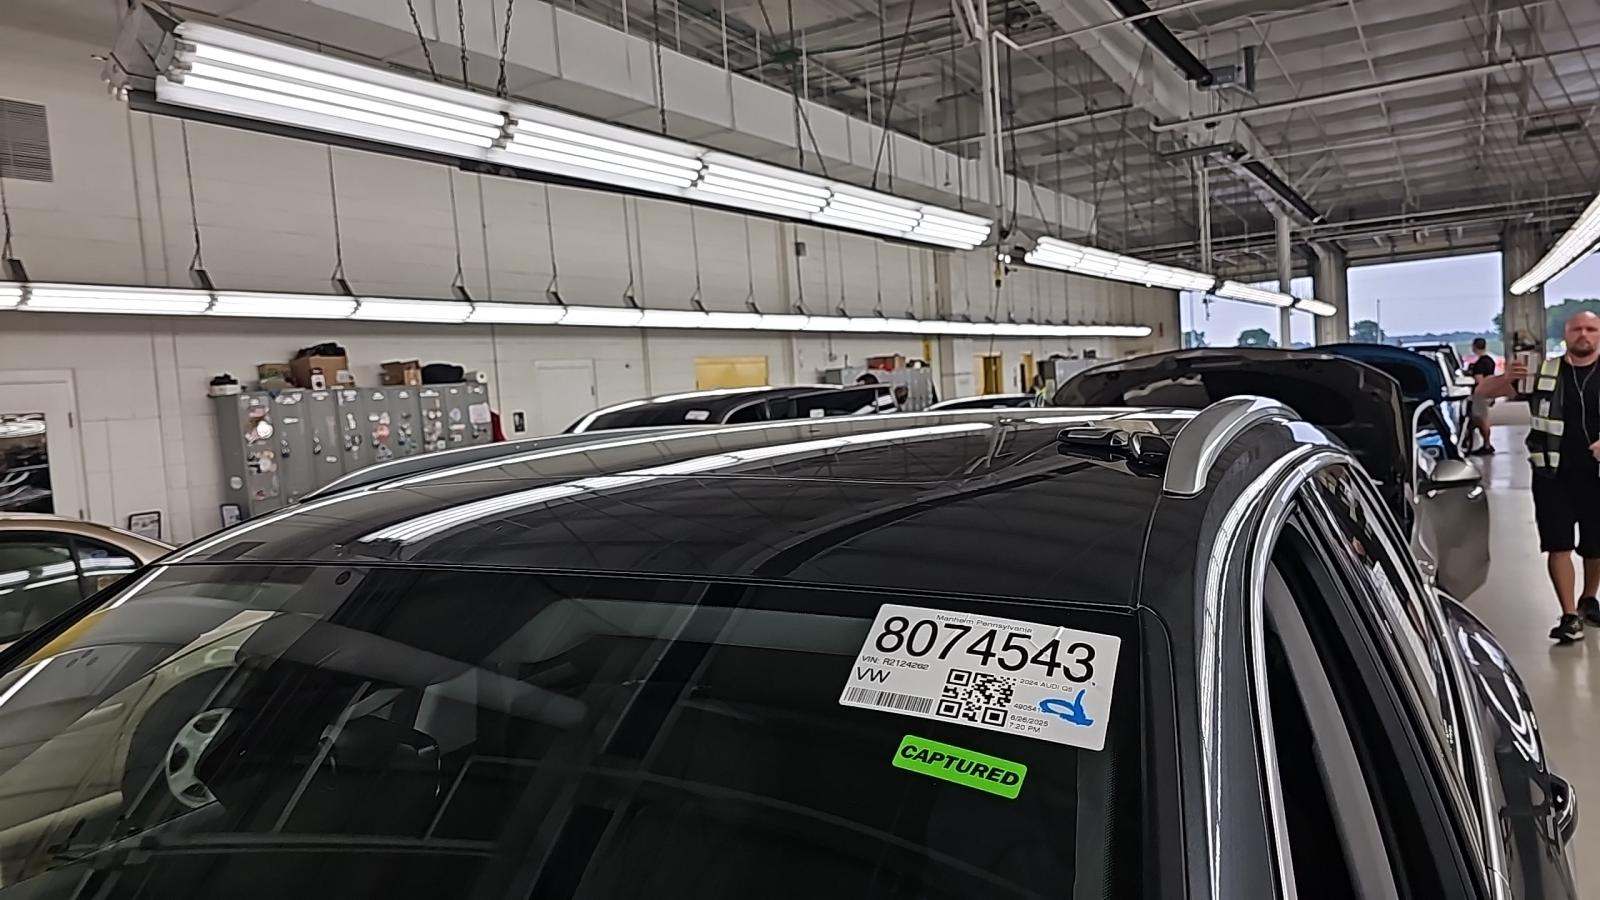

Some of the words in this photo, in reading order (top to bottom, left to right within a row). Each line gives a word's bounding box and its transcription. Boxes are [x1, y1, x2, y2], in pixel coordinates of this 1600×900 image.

[936, 614, 975, 626] Manheim
[976, 619, 1033, 634] Pennsylvania
[876, 616, 1096, 683] 8074543
[862, 655, 879, 664] VIN:
[857, 666, 891, 683] VW
[1020, 678, 1039, 686] 2024
[1040, 682, 1060, 690] AUDI
[1027, 726, 1041, 734] PM
[900, 745, 1020, 786] CAPTURED
